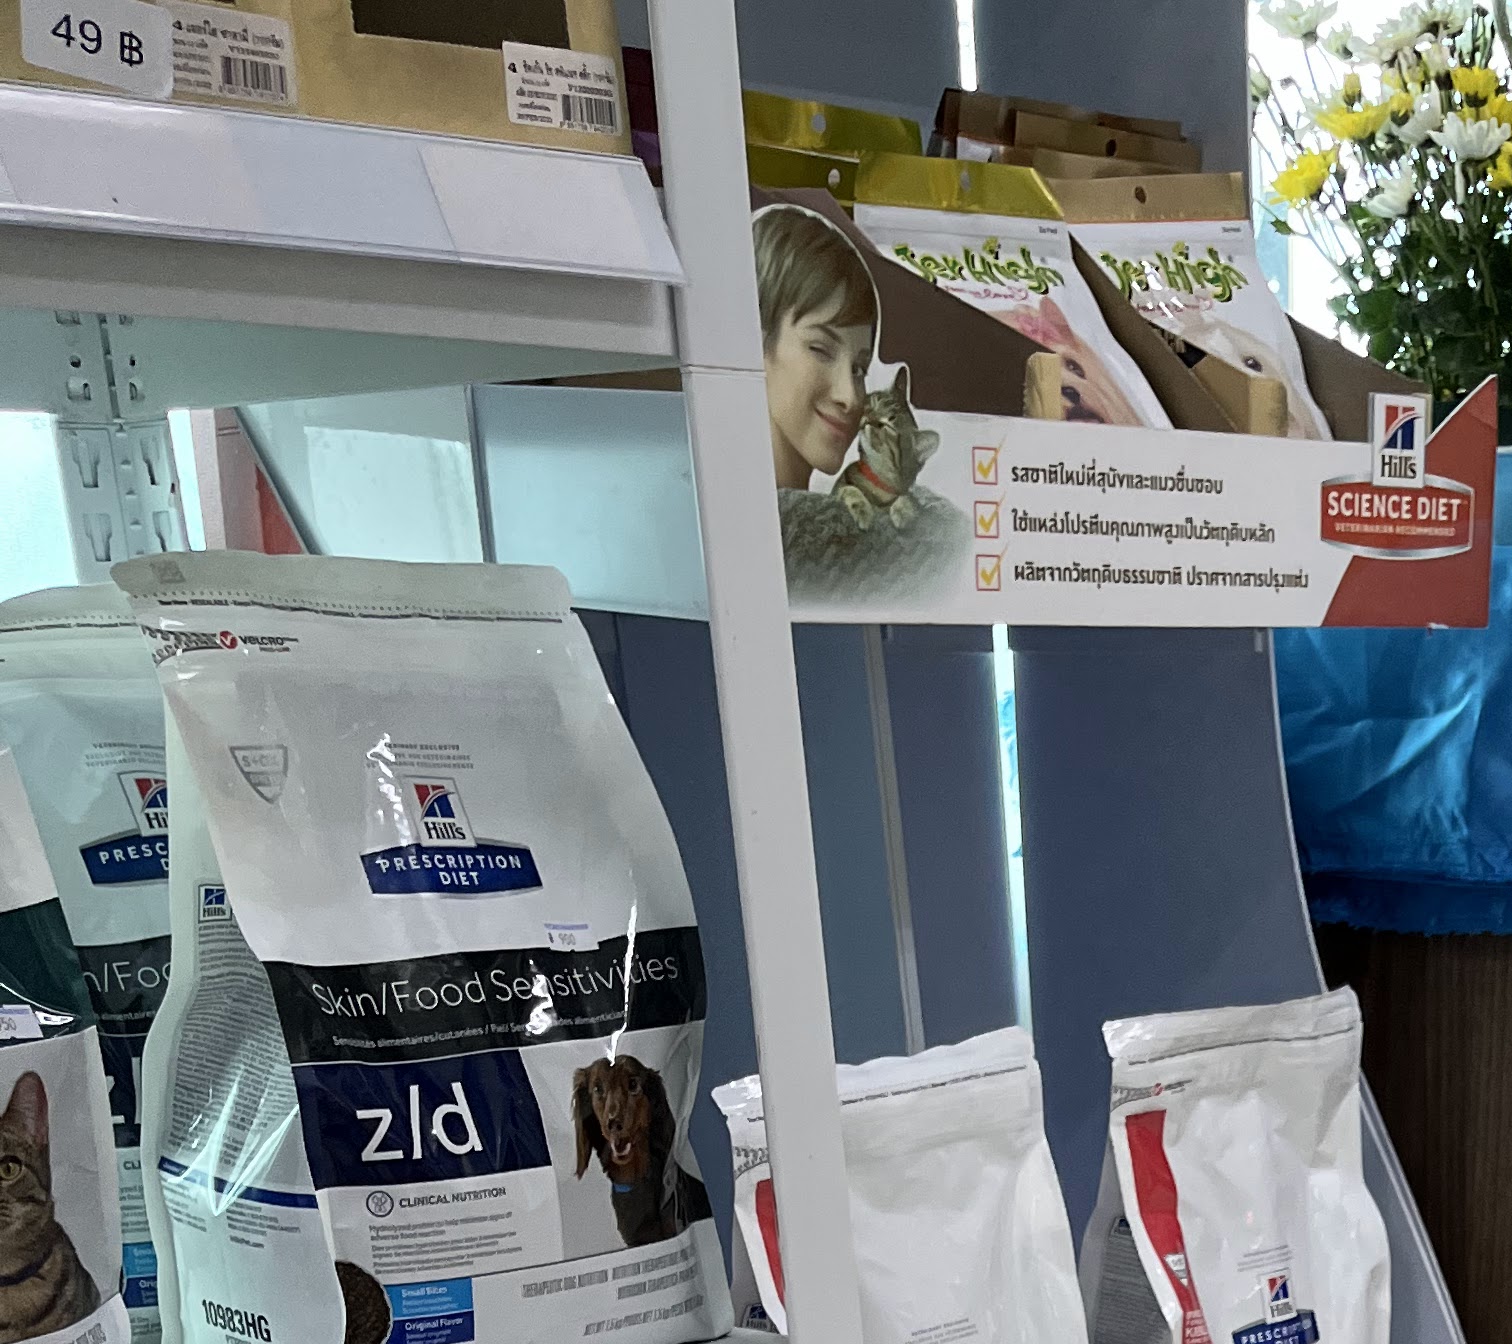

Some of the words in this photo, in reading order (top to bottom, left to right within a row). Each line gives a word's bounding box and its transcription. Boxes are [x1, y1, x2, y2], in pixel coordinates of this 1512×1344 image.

[51, 14, 102, 54] 49
[1381, 454, 1417, 479] Hill's
[1327, 491, 1412, 519] SCIENCE
[1417, 496, 1462, 521] DIET
[424, 821, 467, 840] Hill's
[375, 854, 522, 873] PRESCRIPTION
[438, 871, 481, 886] DIET
[311, 970, 486, 1018] Skin/Food
[356, 1081, 484, 1163] z/d
[399, 1193, 450, 1208] CLINICAL
[451, 1187, 506, 1203] NUTRITION
[202, 1299, 273, 1343] 10983HG
